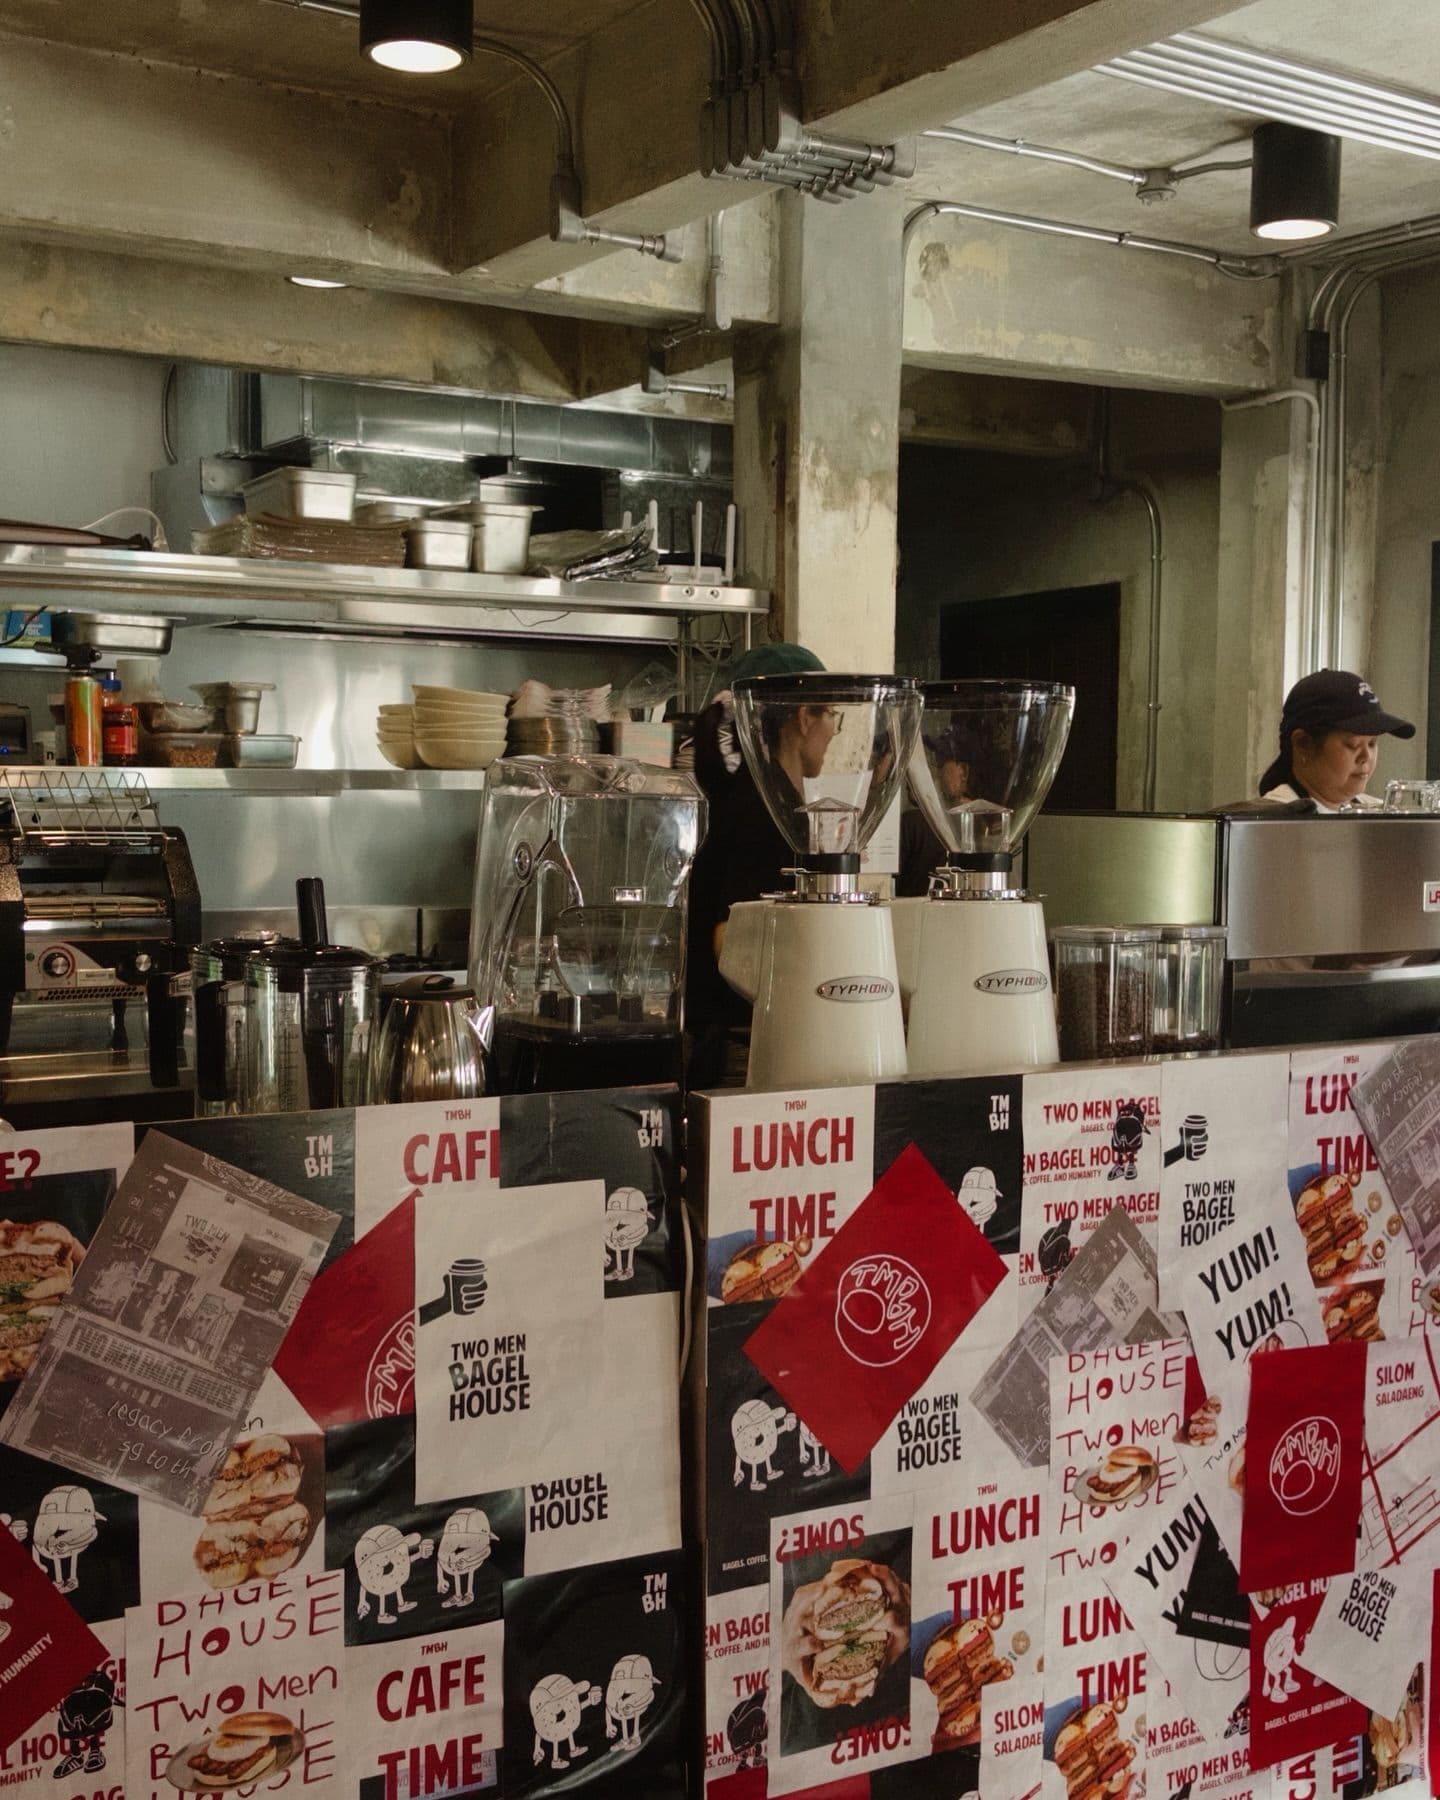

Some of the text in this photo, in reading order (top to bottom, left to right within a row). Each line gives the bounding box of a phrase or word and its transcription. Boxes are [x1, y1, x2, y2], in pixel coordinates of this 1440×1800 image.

[784, 1100, 807, 1112] TMBH
[990, 1094, 1010, 1113] TM
[1305, 1072, 1358, 1116] LUN
[445, 1109, 472, 1121] TMBH
[639, 1109, 663, 1129] TM
[988, 1111, 1010, 1131] BH
[1043, 1102, 1079, 1125] TWO
[1083, 1100, 1112, 1121] MEN
[306, 1135, 333, 1156] TM
[637, 1128, 663, 1149] BH
[732, 1116, 855, 1173] LUNCH
[304, 1155, 333, 1178] BH
[1040, 1149, 1085, 1172] BAGEL
[1054, 1171, 1067, 1182] AND
[1068, 1169, 1101, 1181] HUMANITY
[1185, 1179, 1235, 1198] TWO MEN
[749, 1191, 839, 1246] TIME
[1043, 1201, 1079, 1223] TWO
[1083, 1196, 1112, 1219] MEN
[1182, 1197, 1236, 1223] BAGEL
[1198, 1225, 1281, 1305] YUM!
[1215, 1281, 1294, 1361] YUM!
[451, 1334, 527, 1361] TWO MEN
[448, 1355, 530, 1393] BAGEL
[1067, 1355, 1184, 1414] HOUSE
[1376, 1362, 1415, 1386] SILOM
[449, 1382, 531, 1422] HOUSE
[933, 1392, 958, 1412] MEN
[1375, 1385, 1424, 1407] SALADAENG
[107, 1400, 174, 1440] legacy
[897, 1411, 961, 1446] BAGEL
[1131, 1412, 1180, 1445] Men
[146, 1449, 169, 1471] to
[897, 1436, 962, 1473] HOUSE
[1271, 1421, 1339, 1477] TMBH
[977, 1483, 998, 1495] TMBH
[529, 1493, 609, 1533] HOUSE
[932, 1494, 1041, 1559] LUNCH
[775, 1514, 866, 1563] SOME?
[644, 1572, 668, 1593] TM
[947, 1566, 1025, 1626] TIME
[1380, 1579, 1398, 1599] MEN
[641, 1592, 667, 1614] BH
[1349, 1578, 1391, 1621] BAGEL
[153, 1591, 342, 1679] HOUSE
[1338, 1599, 1386, 1643] HOUSE
[1, 1633, 54, 1684] HUMANITY
[421, 1641, 448, 1656] TMBH
[745, 1639, 760, 1650] AND
[257, 1665, 338, 1710] Men
[376, 1654, 486, 1723] CAFE
[1076, 1651, 1147, 1712] TIME
[994, 1701, 1044, 1735] SILOM
[378, 1733, 483, 1800] TIME
[1167, 1765, 1199, 1791] TWO
[1202, 1754, 1229, 1779] MEN
